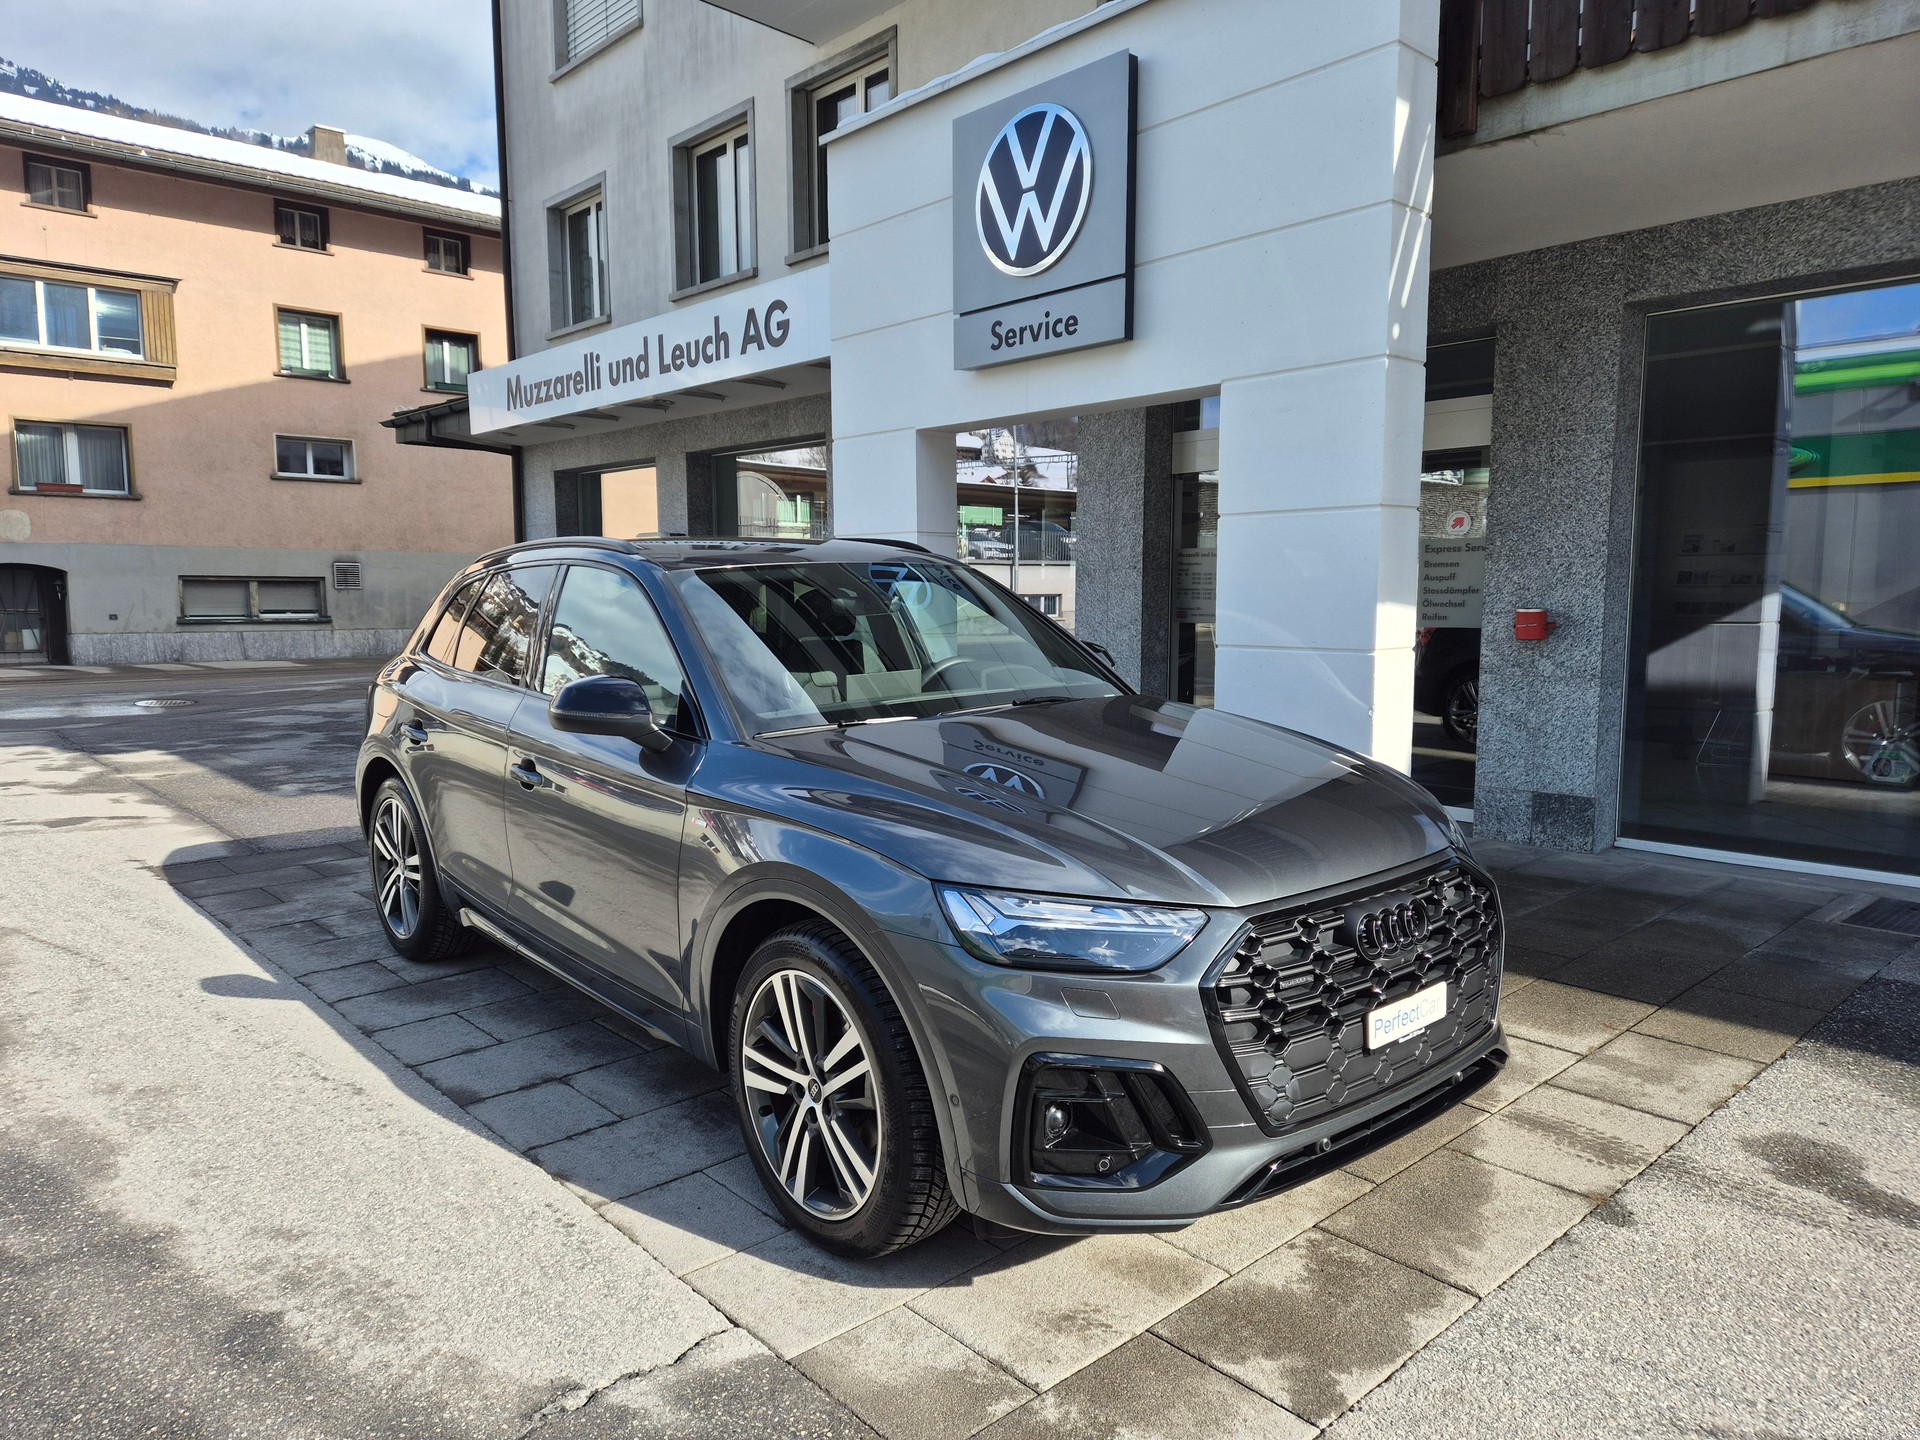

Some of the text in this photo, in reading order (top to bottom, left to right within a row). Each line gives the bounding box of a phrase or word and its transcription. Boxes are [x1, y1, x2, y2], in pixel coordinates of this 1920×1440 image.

[990, 311, 1079, 350] Service
[506, 299, 791, 411] Muzzarelli und Leuch AG
[1424, 543, 1486, 555] Express Serv
[1423, 560, 1460, 568] Bremsen
[1423, 573, 1456, 582] Auspuff
[1423, 586, 1480, 596] Stossdämpfer
[1422, 599, 1466, 608] Ölwechsel
[1421, 612, 1448, 621] Reifen
[1374, 996, 1441, 1039] PerfectCar
